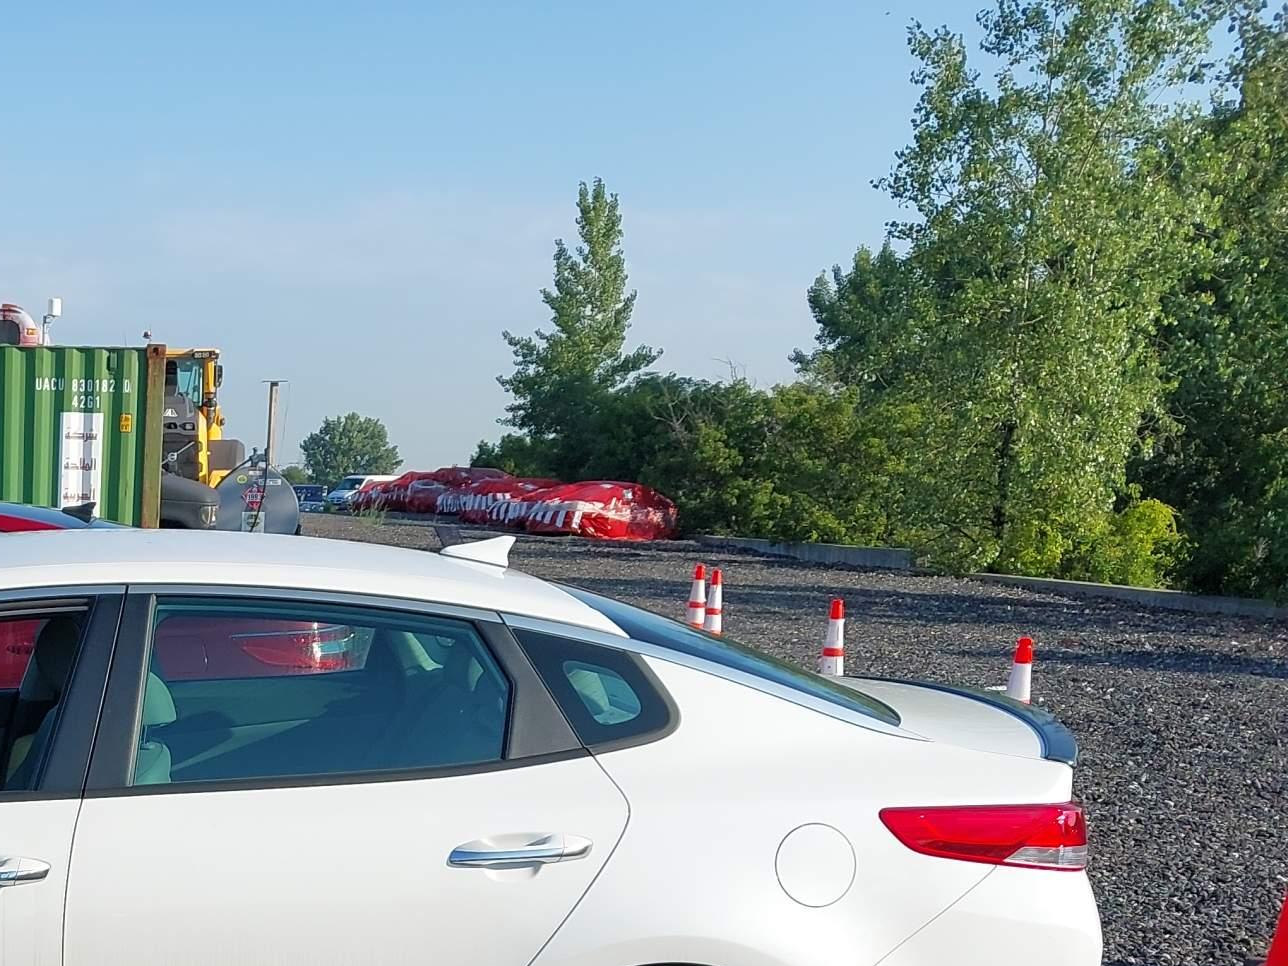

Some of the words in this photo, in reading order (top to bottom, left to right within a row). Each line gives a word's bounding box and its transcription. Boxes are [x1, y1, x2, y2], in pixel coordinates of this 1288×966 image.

[35, 377, 64, 391] UACU
[71, 379, 116, 393] 830182
[72, 395, 100, 409] 42G1
